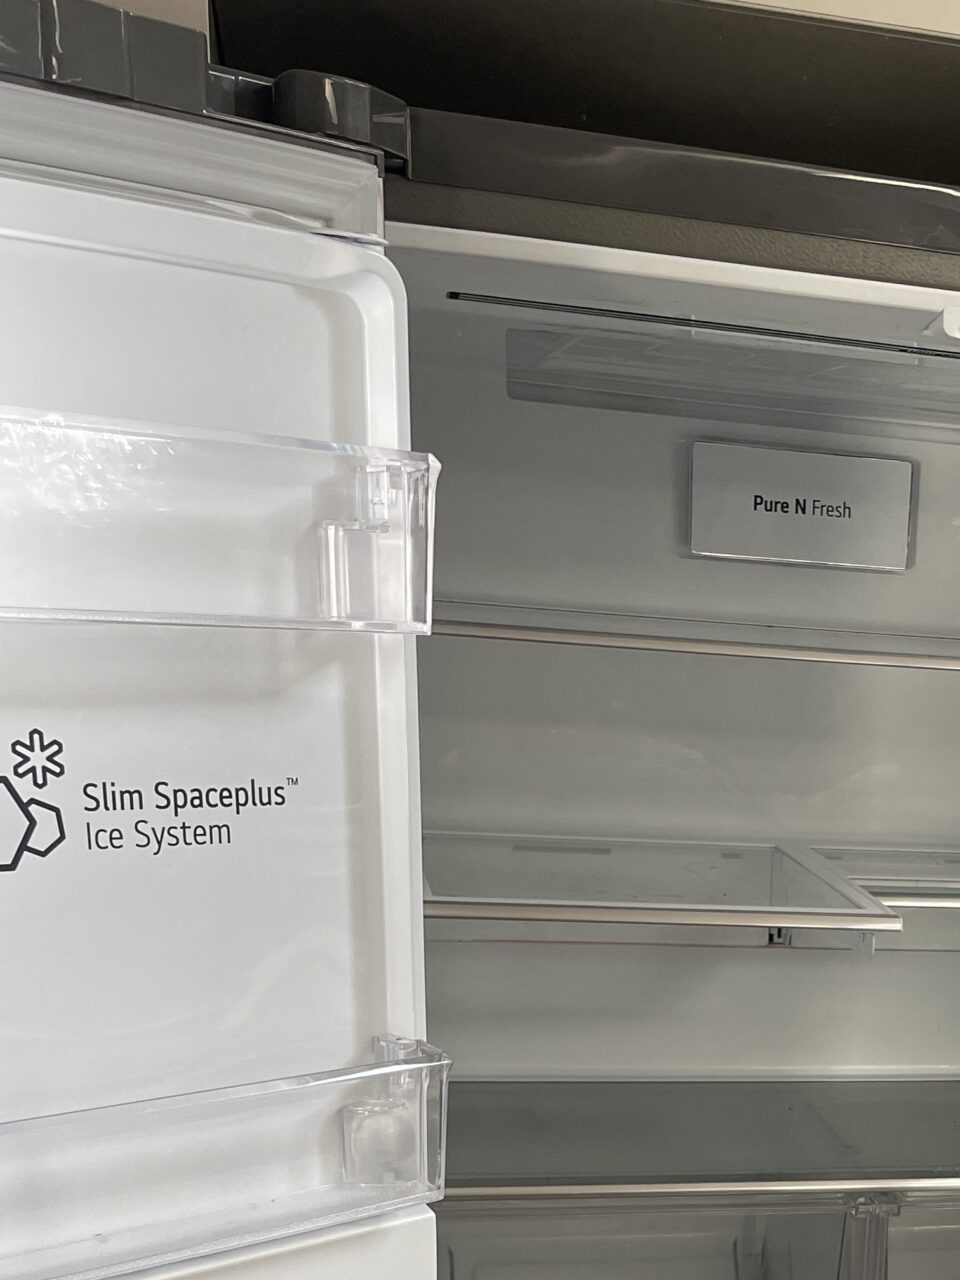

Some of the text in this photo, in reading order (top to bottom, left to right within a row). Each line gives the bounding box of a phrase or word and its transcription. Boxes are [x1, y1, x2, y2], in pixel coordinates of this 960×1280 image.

[753, 494, 852, 518] Pure N Fresh
[82, 782, 145, 812] Slim
[85, 819, 232, 855] Ice System
